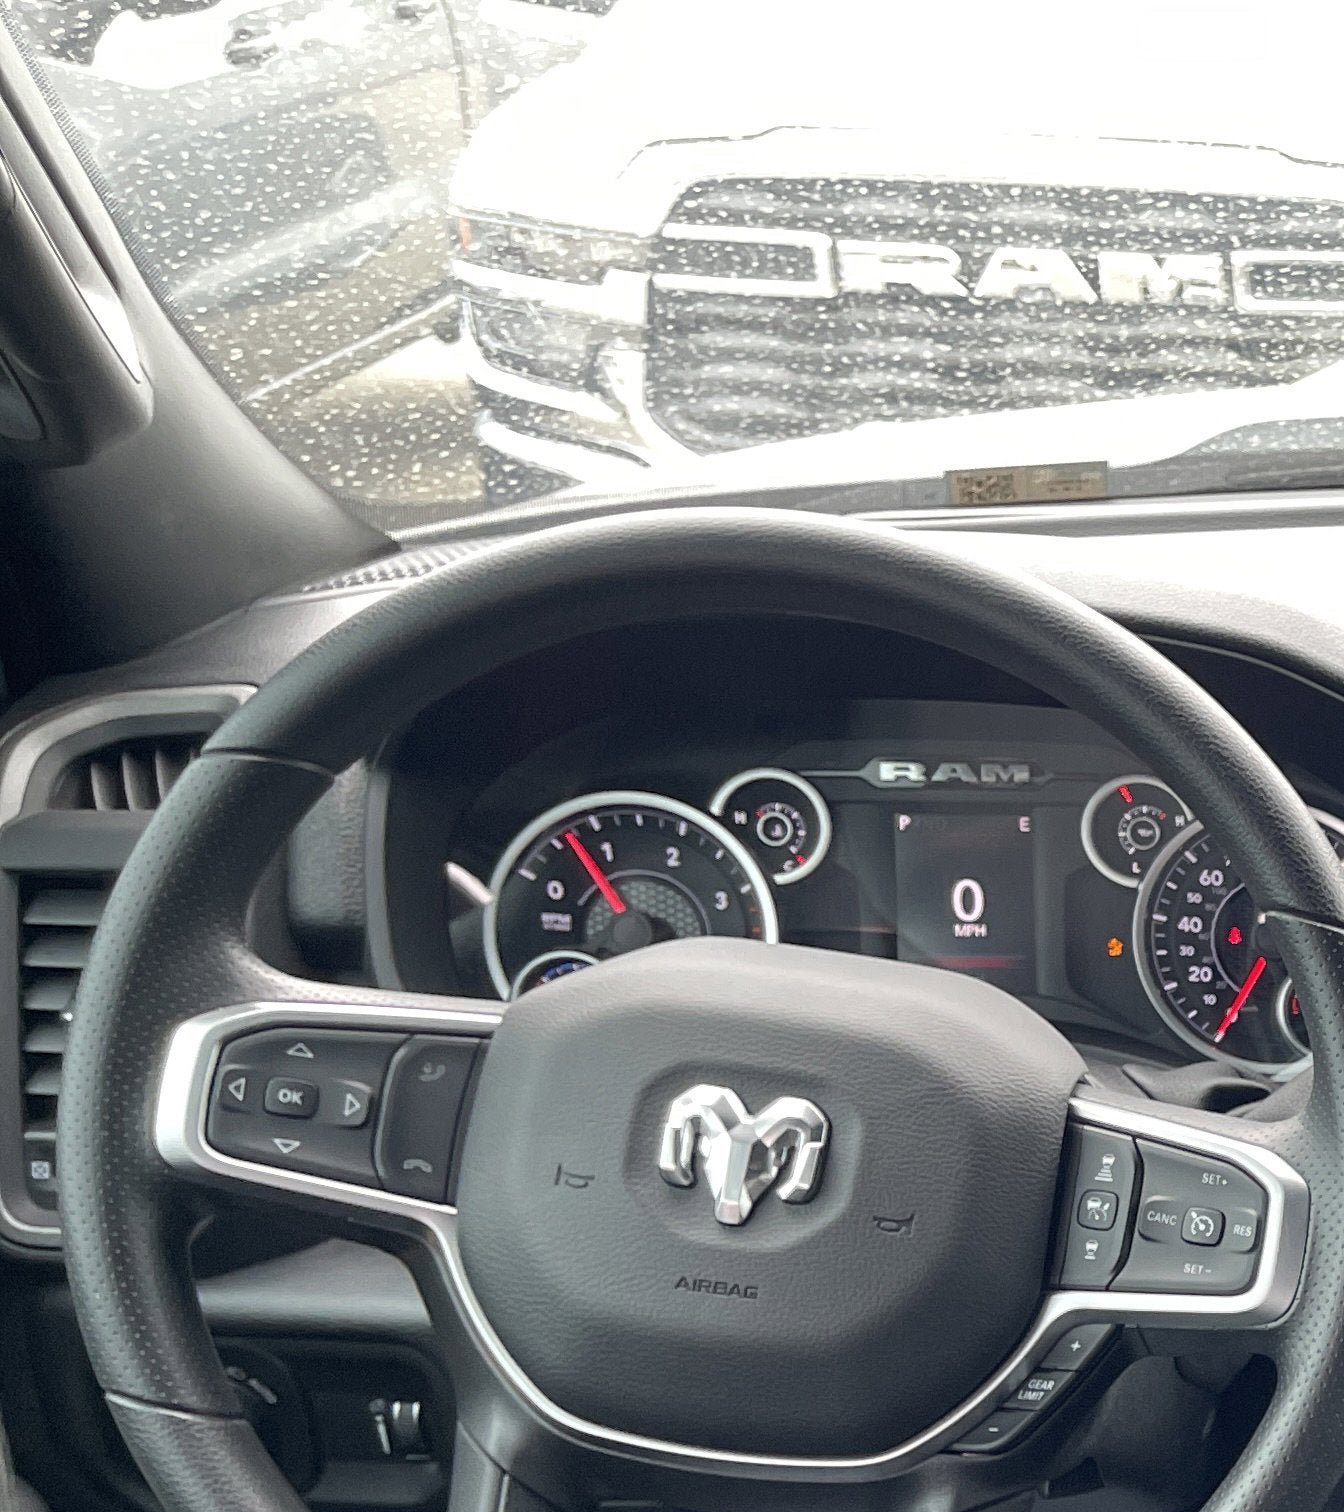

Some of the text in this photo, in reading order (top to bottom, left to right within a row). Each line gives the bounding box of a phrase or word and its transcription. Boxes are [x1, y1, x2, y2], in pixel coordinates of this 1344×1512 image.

[837, 239, 1224, 304] RAM
[879, 761, 1030, 783] RAM
[899, 814, 911, 831] P
[1019, 816, 1031, 832] E
[601, 842, 613, 862] 1
[666, 846, 681, 868] 2
[1199, 869, 1224, 886] 60
[547, 880, 564, 900] 0
[1186, 892, 1203, 904] 50
[714, 891, 728, 910] 3
[952, 878, 985, 922] 0
[954, 924, 988, 937] MPH
[1178, 916, 1203, 934] 40
[1179, 945, 1195, 957] 30
[1188, 965, 1213, 983] 20
[1203, 993, 1217, 1006] 10
[278, 1088, 304, 1106] OK
[1146, 1210, 1178, 1226] CANC
[1233, 1224, 1252, 1237] RES
[674, 1276, 759, 1299] AIRBAG
[1028, 1378, 1055, 1391] GEAR
[1018, 1389, 1045, 1401] LIMIT
